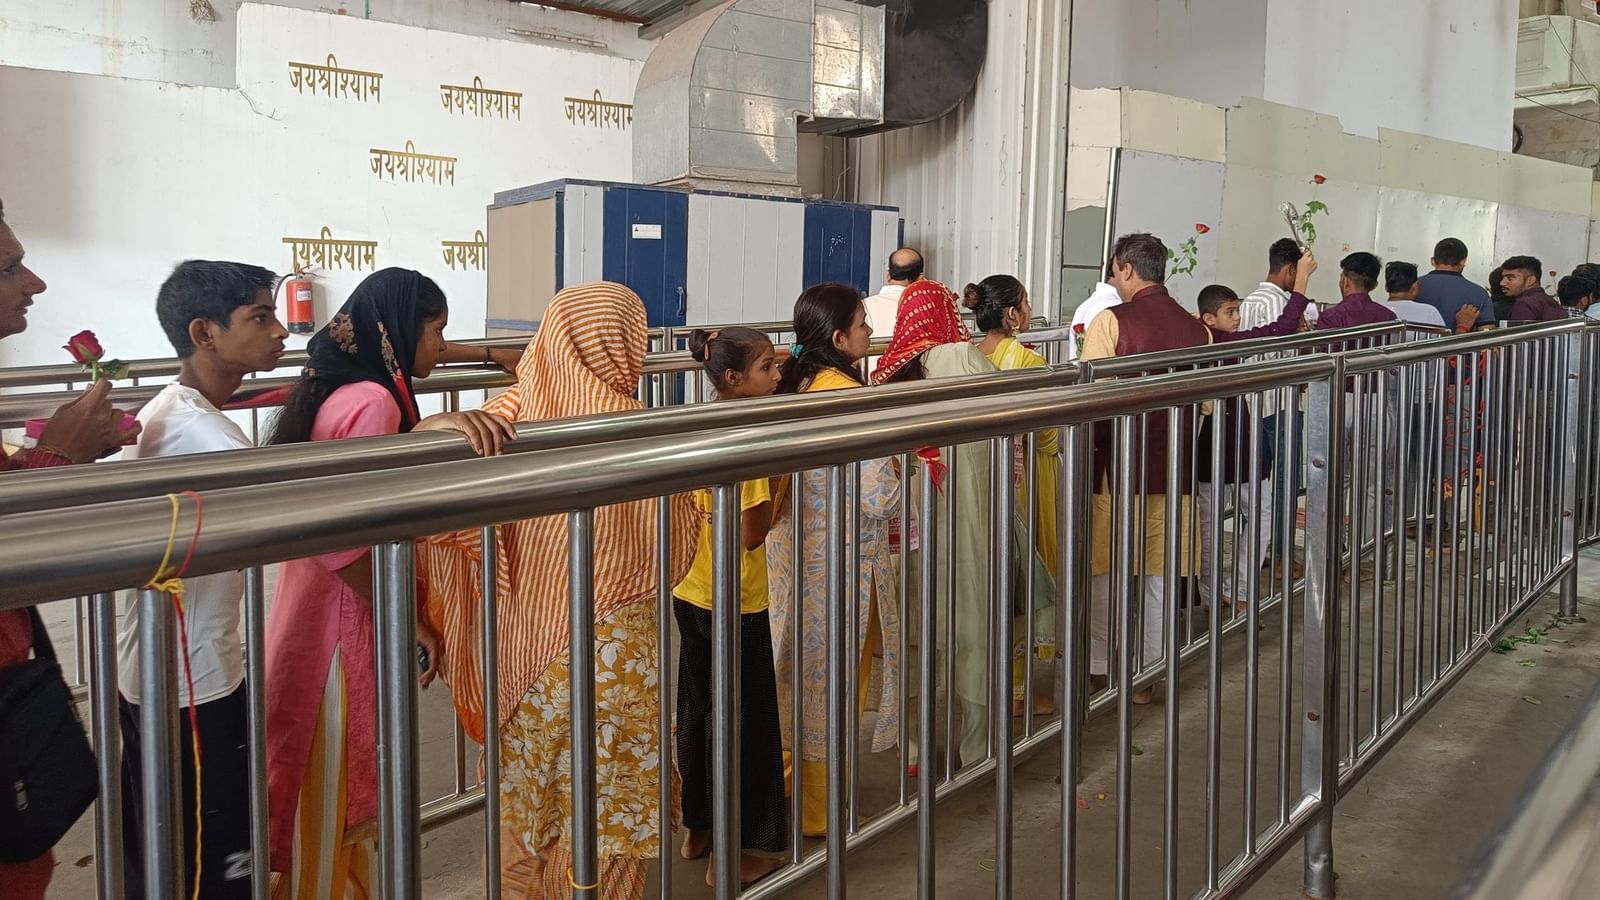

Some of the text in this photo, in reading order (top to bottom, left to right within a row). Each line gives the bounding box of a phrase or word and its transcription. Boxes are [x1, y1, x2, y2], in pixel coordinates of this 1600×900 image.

[288, 53, 383, 104] जयश्रीश्याम
[440, 76, 522, 121] जयश्रीश्याम
[370, 140, 457, 187] जयश्रीश्याम
[441, 230, 488, 271] जयश्री
